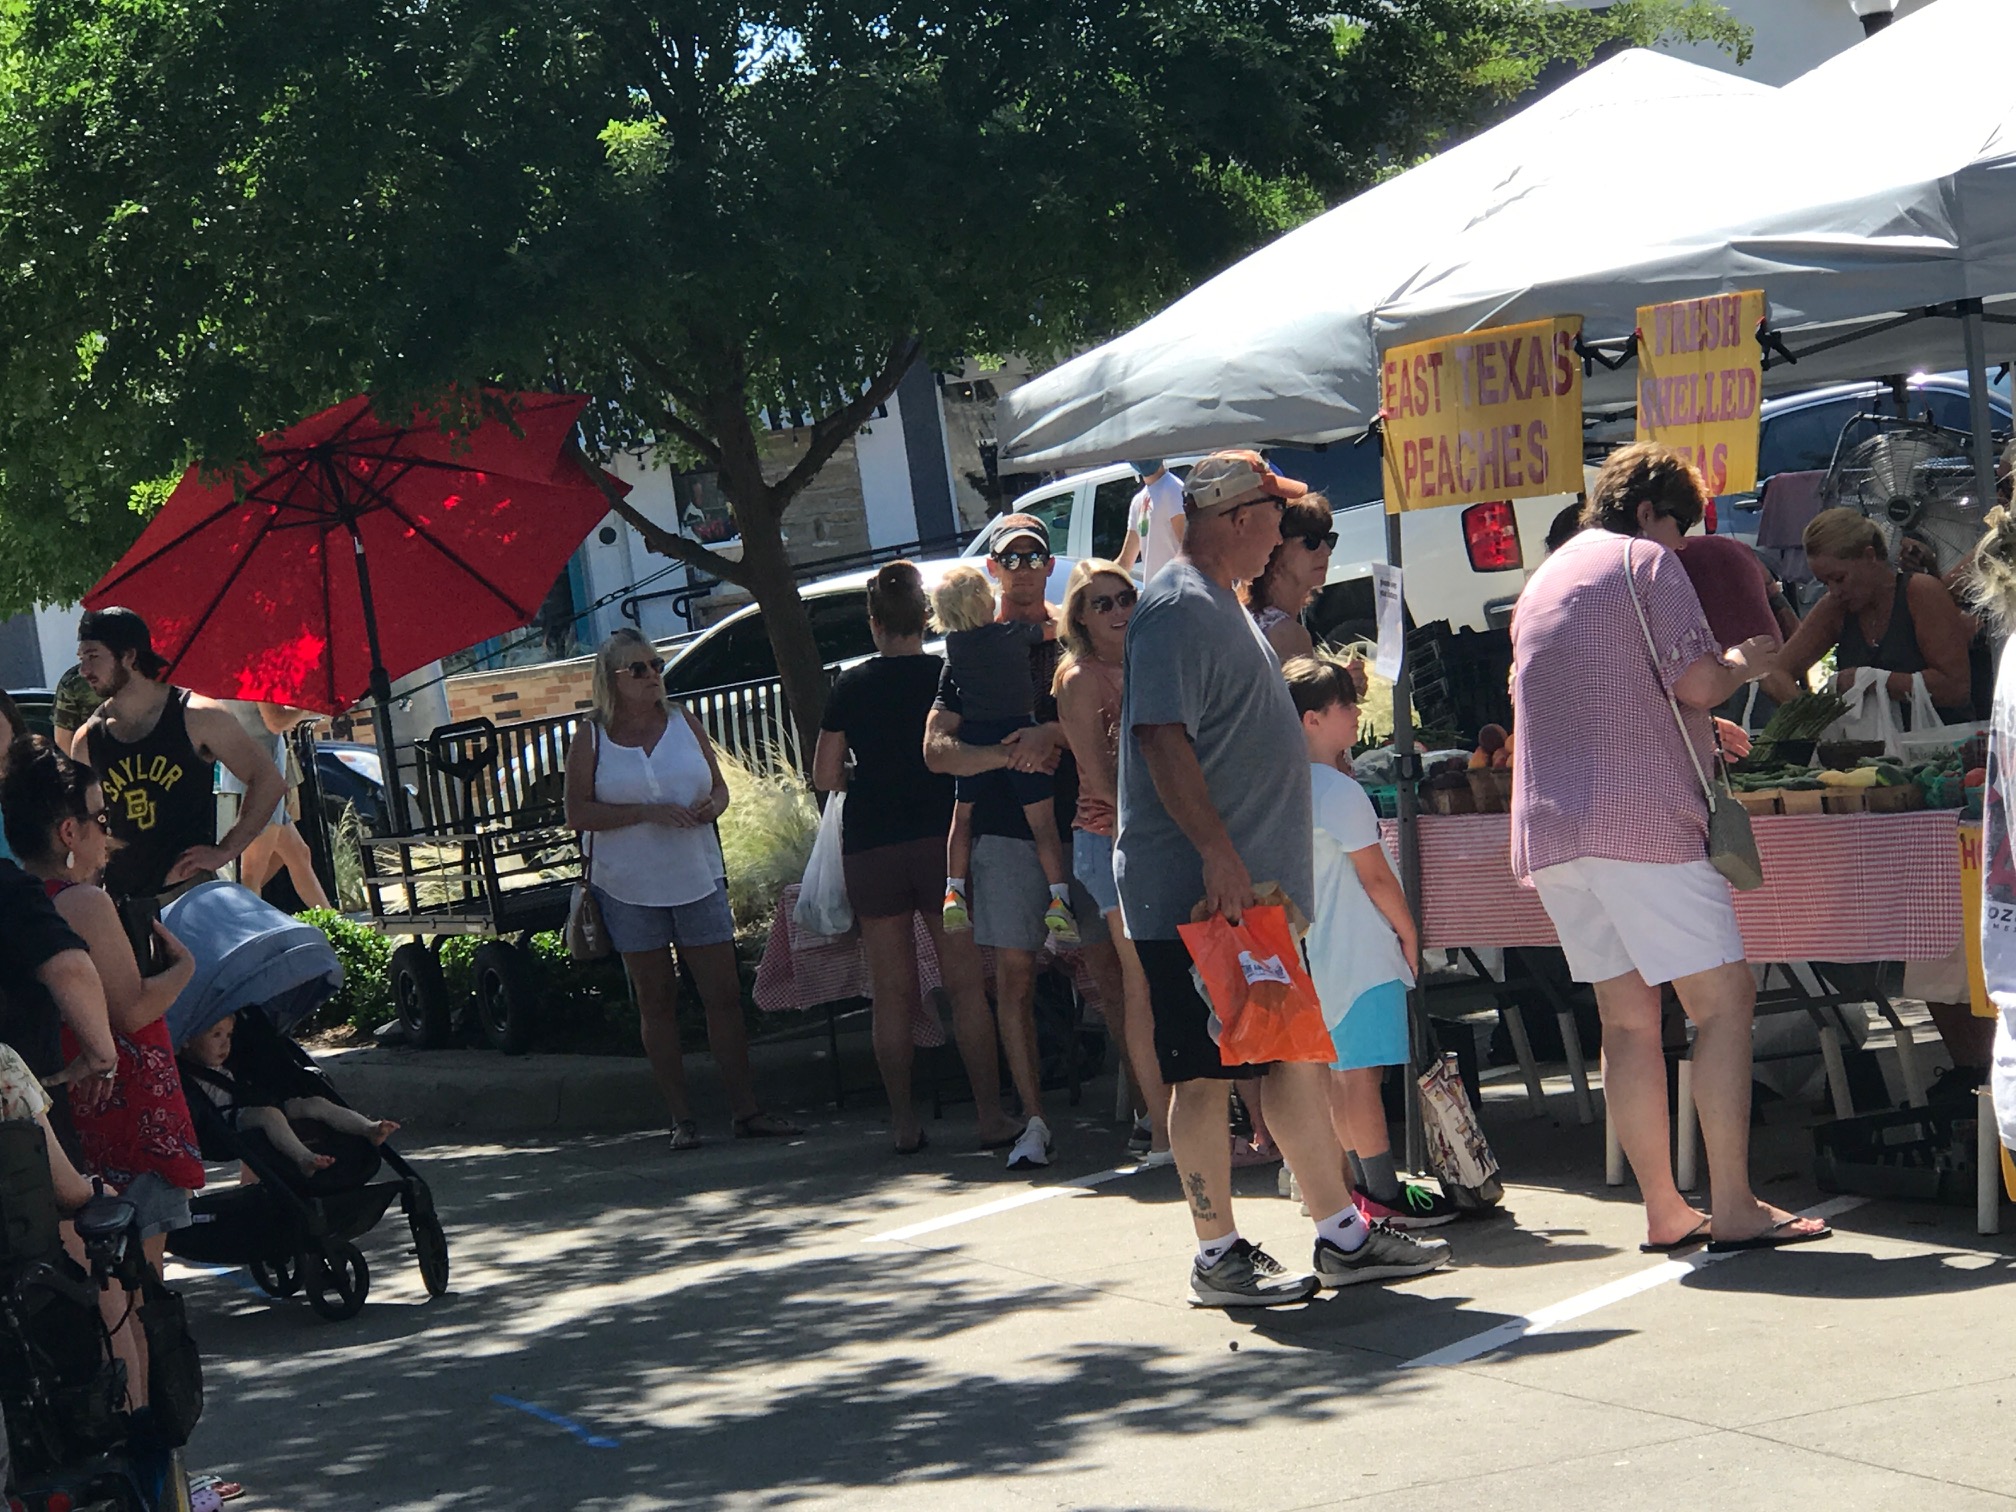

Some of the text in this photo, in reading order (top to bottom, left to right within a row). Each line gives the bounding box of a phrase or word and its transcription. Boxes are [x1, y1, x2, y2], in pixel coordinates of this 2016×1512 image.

[1654, 295, 1742, 356] FRESH
[1385, 330, 1573, 420] EAST TEXAS
[1641, 367, 1756, 430] SHELLED
[1403, 420, 1548, 498] PEACHES
[1676, 443, 1728, 496] AS
